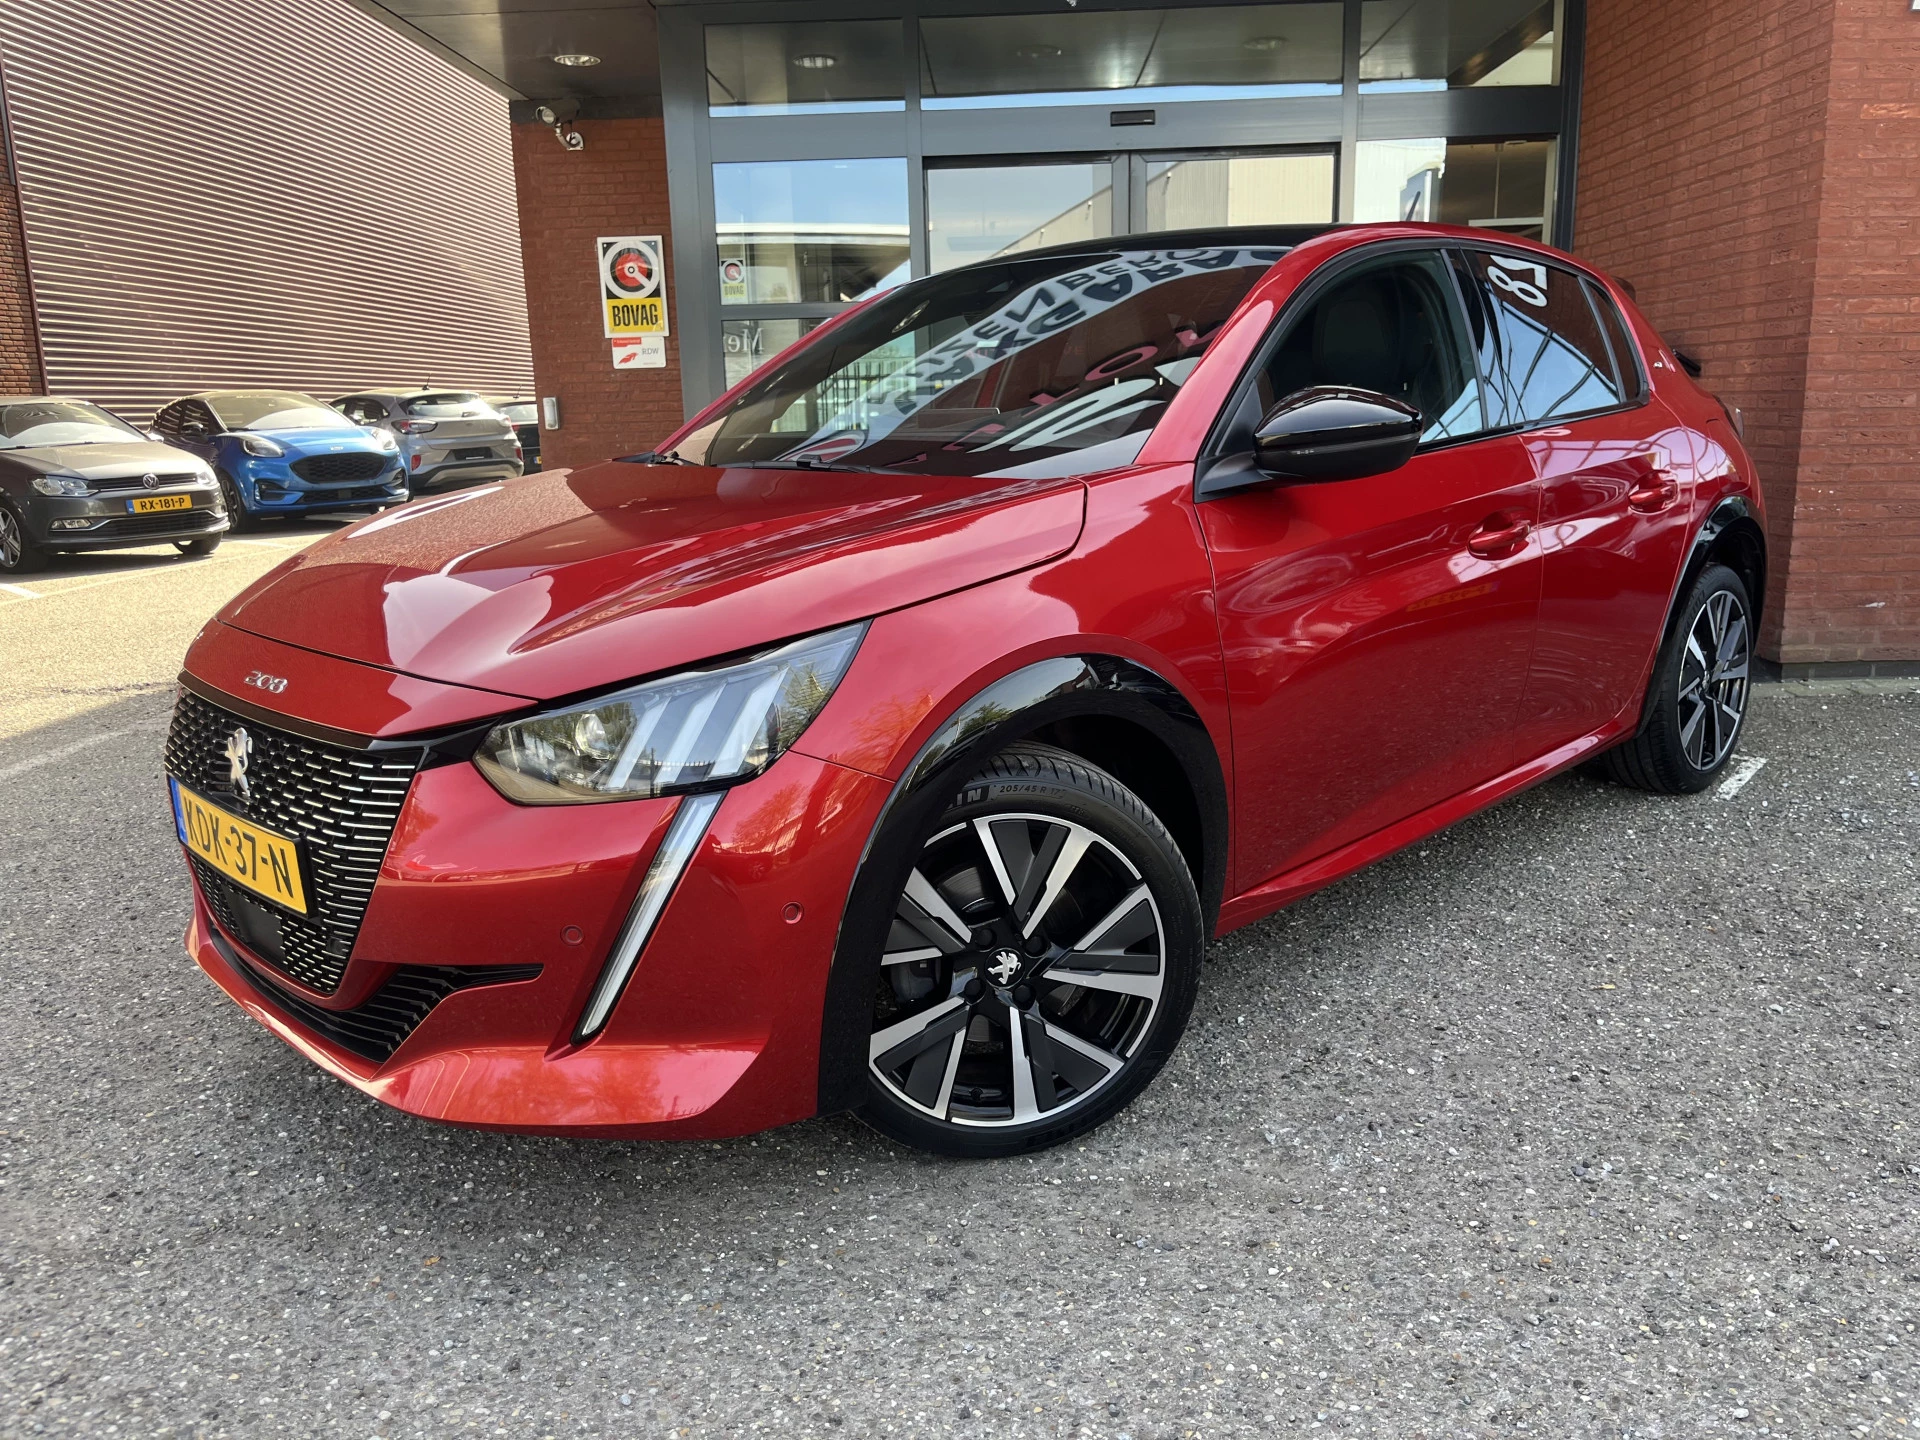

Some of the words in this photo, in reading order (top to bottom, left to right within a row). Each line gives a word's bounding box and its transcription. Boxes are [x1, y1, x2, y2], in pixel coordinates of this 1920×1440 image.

[612, 304, 658, 327] BOVAG
[140, 498, 185, 511] RX-181-P
[243, 670, 288, 694] 208
[999, 784, 1037, 793] 205/45
[183, 795, 294, 899] KDK-37-N
